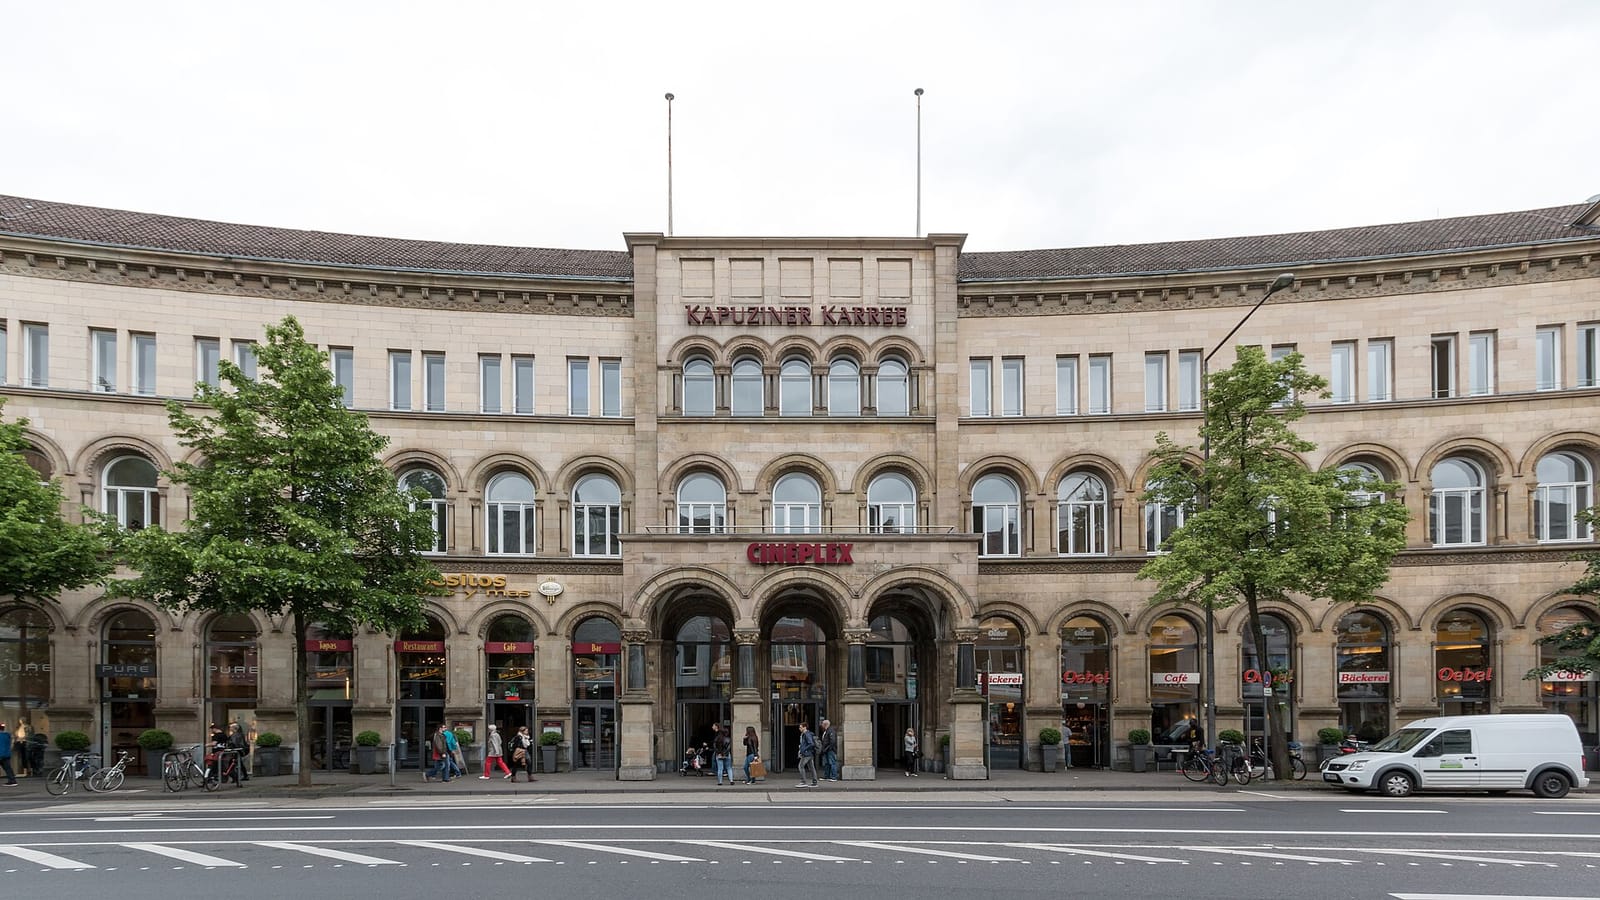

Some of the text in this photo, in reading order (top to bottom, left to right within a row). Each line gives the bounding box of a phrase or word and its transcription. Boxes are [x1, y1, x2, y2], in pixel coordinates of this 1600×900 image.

[684, 304, 908, 327] KAPUZINER KARREE
[746, 542, 854, 565] CINEPLEX
[464, 589, 477, 600] y
[485, 588, 531, 598] mas
[319, 640, 337, 651] Tapas
[403, 641, 437, 651] Restaurant
[591, 643, 602, 653] Bar
[102, 665, 149, 673] PURE
[208, 665, 259, 674] PURE
[1438, 666, 1493, 682] Oebel
[1062, 670, 1110, 684] Oebel
[1164, 673, 1188, 684] Café
[1341, 673, 1388, 682] Bäckerei
